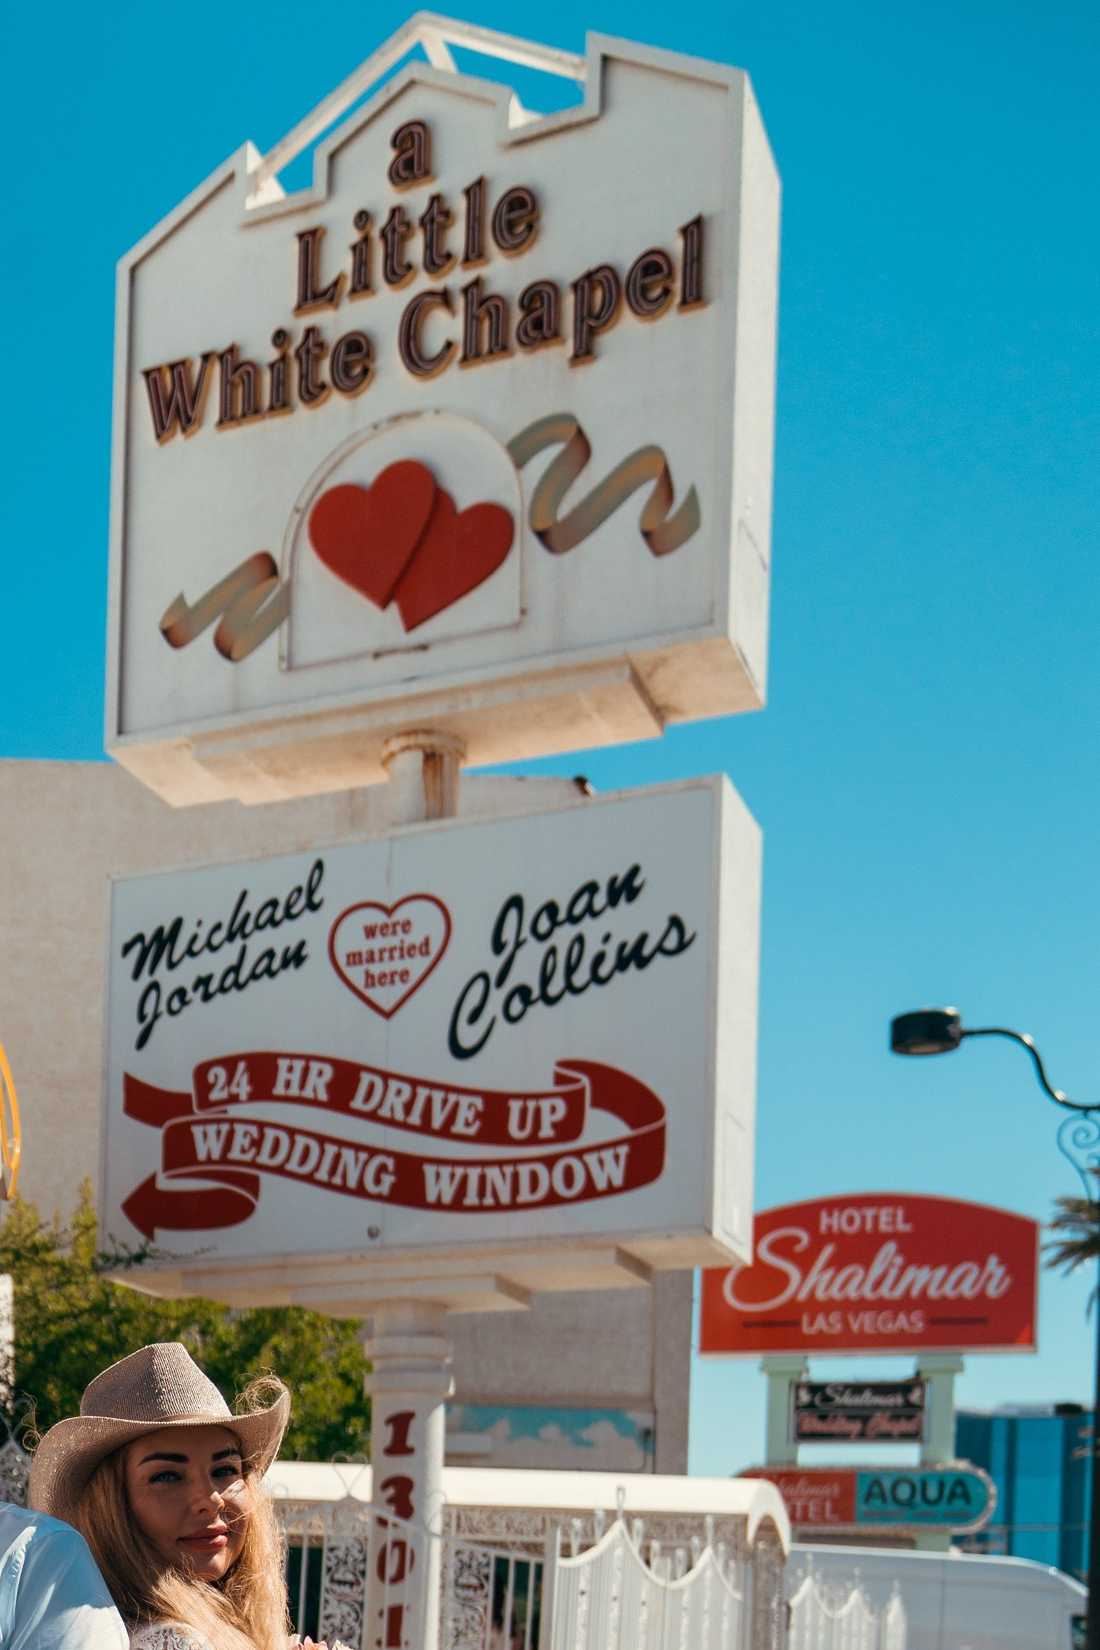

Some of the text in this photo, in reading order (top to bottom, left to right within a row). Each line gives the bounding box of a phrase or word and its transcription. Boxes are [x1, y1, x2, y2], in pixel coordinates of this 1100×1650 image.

[387, 119, 436, 194] a
[293, 171, 541, 319] Little
[141, 211, 710, 447] White Chapel
[122, 858, 325, 982] Michael
[345, 935, 431, 967] married
[363, 917, 413, 940] were
[491, 863, 647, 984] Joan
[135, 939, 309, 1051] Jordan
[364, 965, 410, 990] here
[447, 913, 697, 1061] Collins
[206, 1057, 568, 1140] 24 HR DRIVE UP
[191, 1122, 633, 1207] WEDDING WINDOW
[820, 1206, 913, 1234] HOTEL
[722, 1226, 1012, 1313] Shalimar
[802, 1309, 926, 1335] LAS VEGAS
[814, 1383, 904, 1408] Shalimar
[762, 1471, 842, 1499] halimar
[786, 1498, 842, 1522] TEL
[863, 1477, 972, 1507] AQUA
[375, 1410, 417, 1650] 1301
